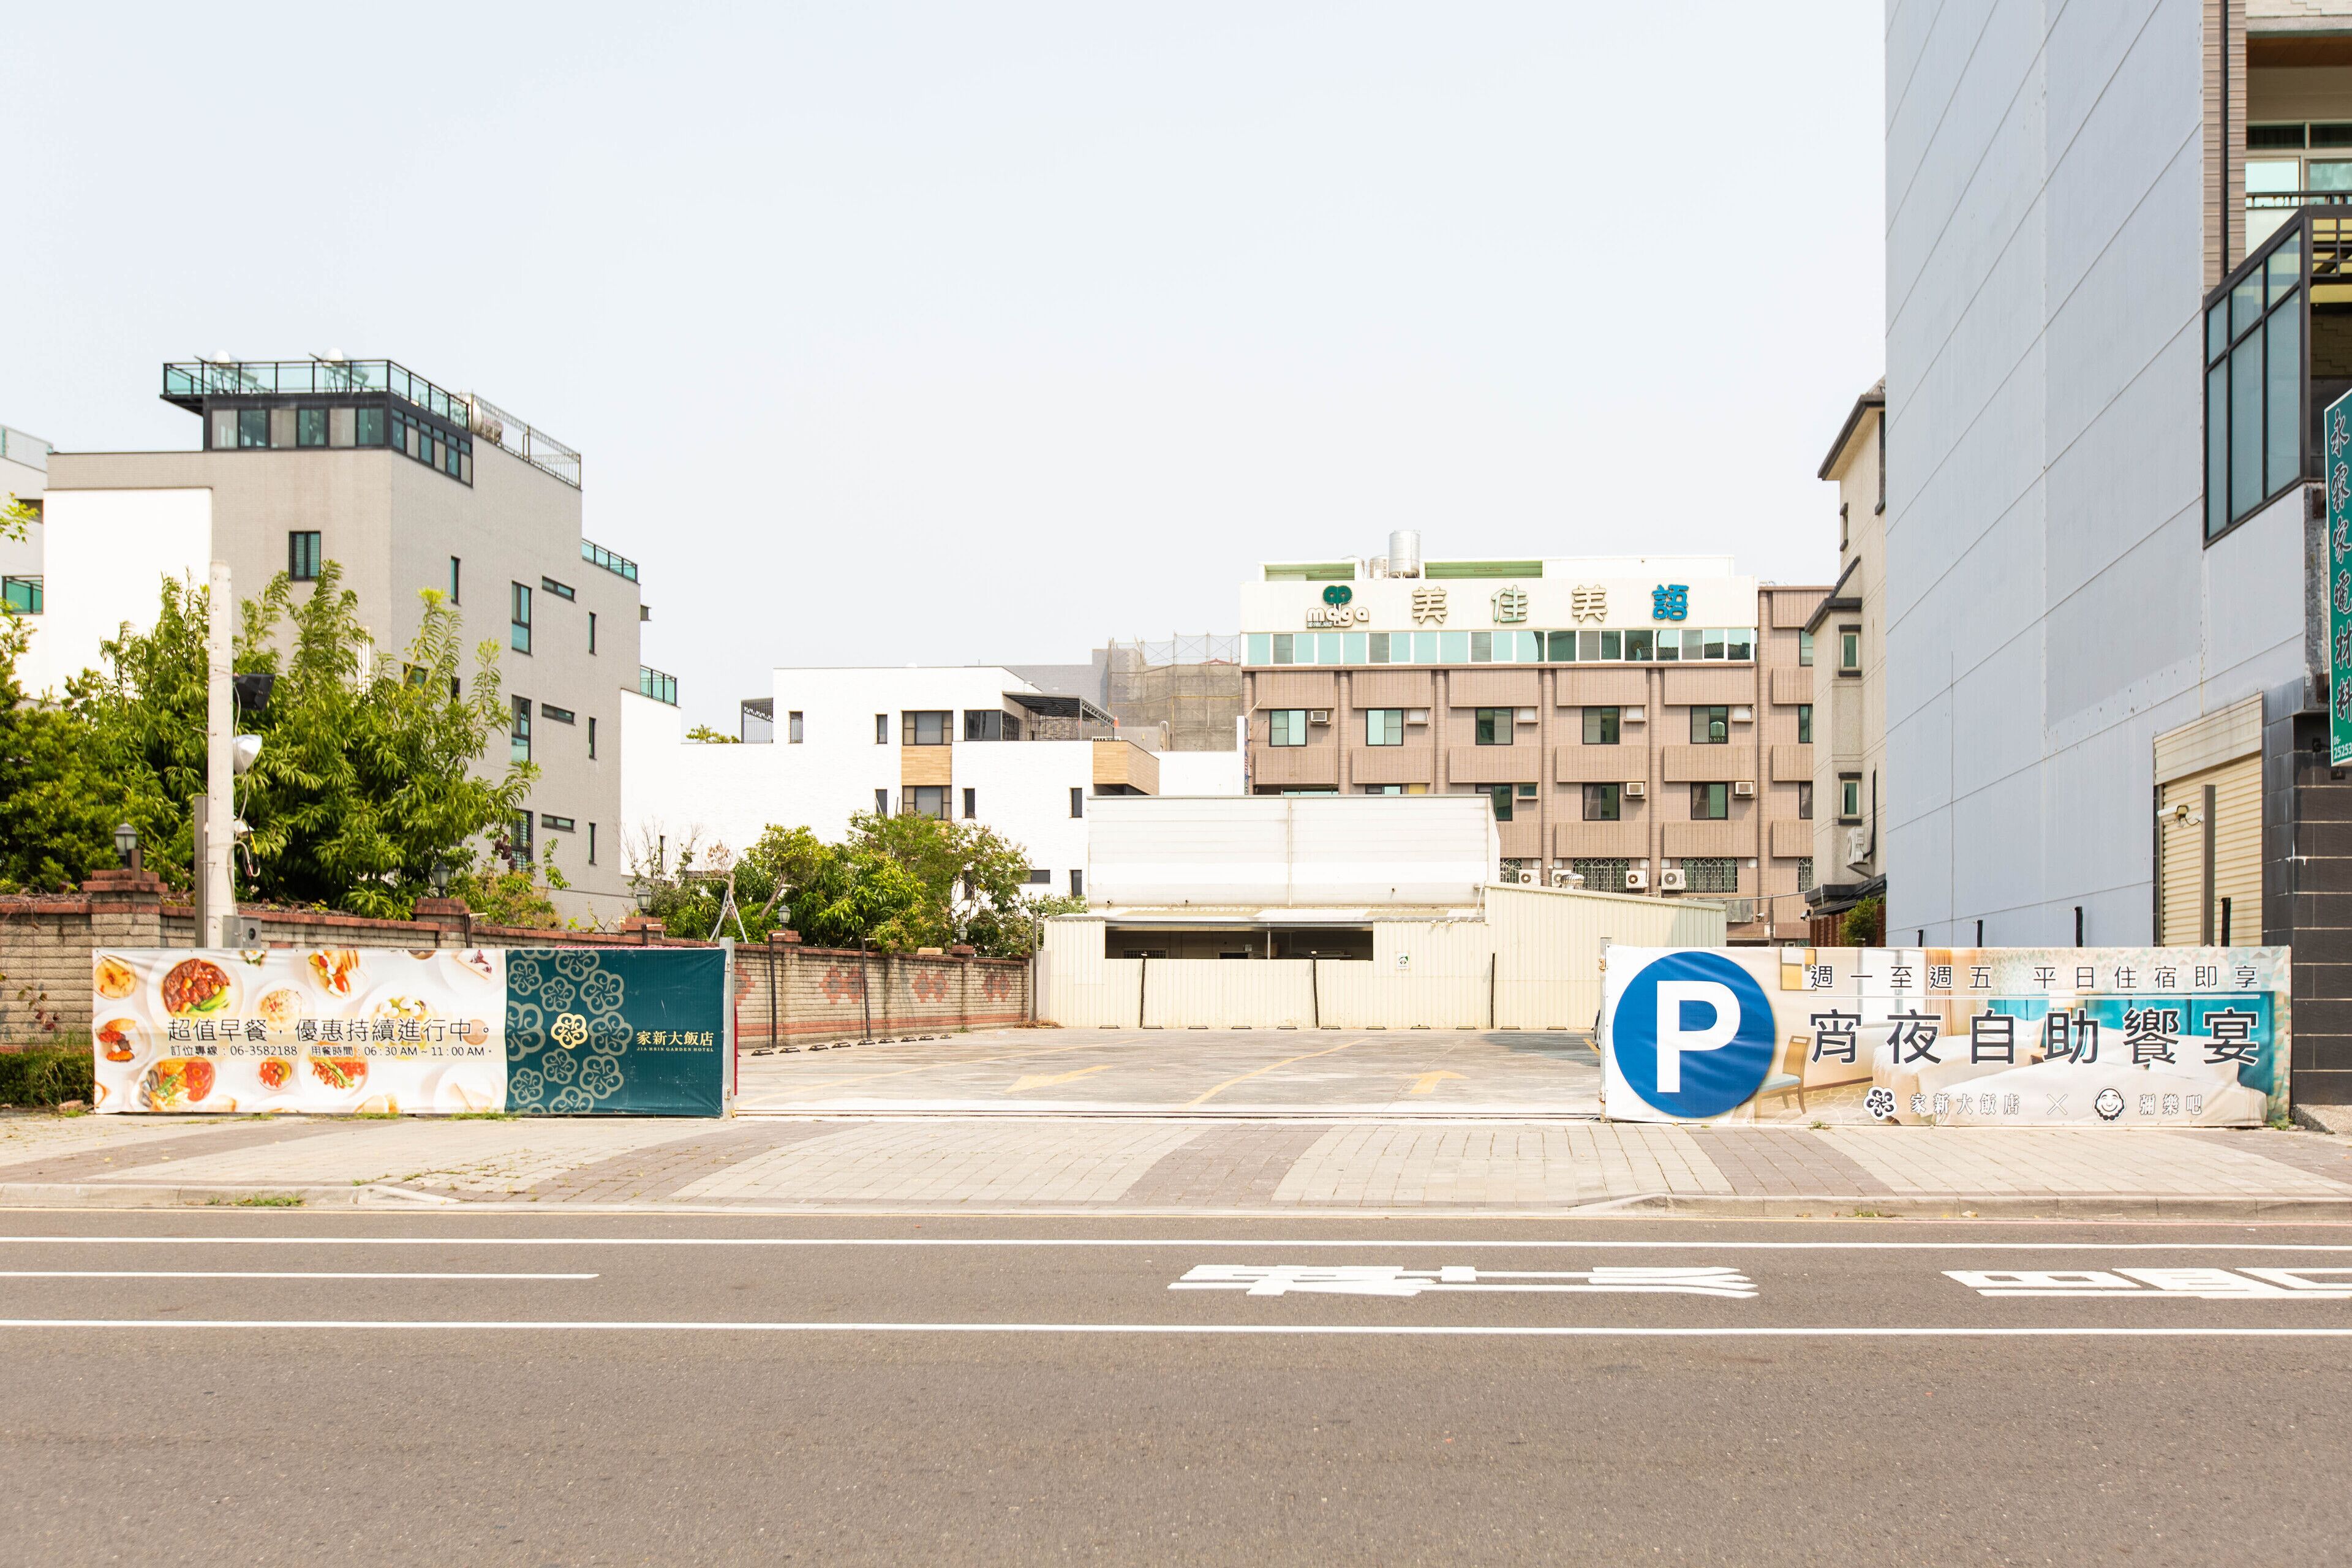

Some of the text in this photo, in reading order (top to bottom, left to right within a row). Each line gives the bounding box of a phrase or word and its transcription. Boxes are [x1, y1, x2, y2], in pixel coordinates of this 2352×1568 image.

[1412, 584, 1689, 624] 美佳美語
[1811, 965, 2258, 989] 週一至週五 平日住宿即享
[637, 1030, 714, 1046] 家新大飯店
[1657, 981, 1741, 1093] P
[1810, 1008, 2258, 1065] 宵夜自助饗宴
[1910, 1093, 2020, 1115] 家新大飯店
[2139, 1093, 2202, 1115] 彌樂吧
